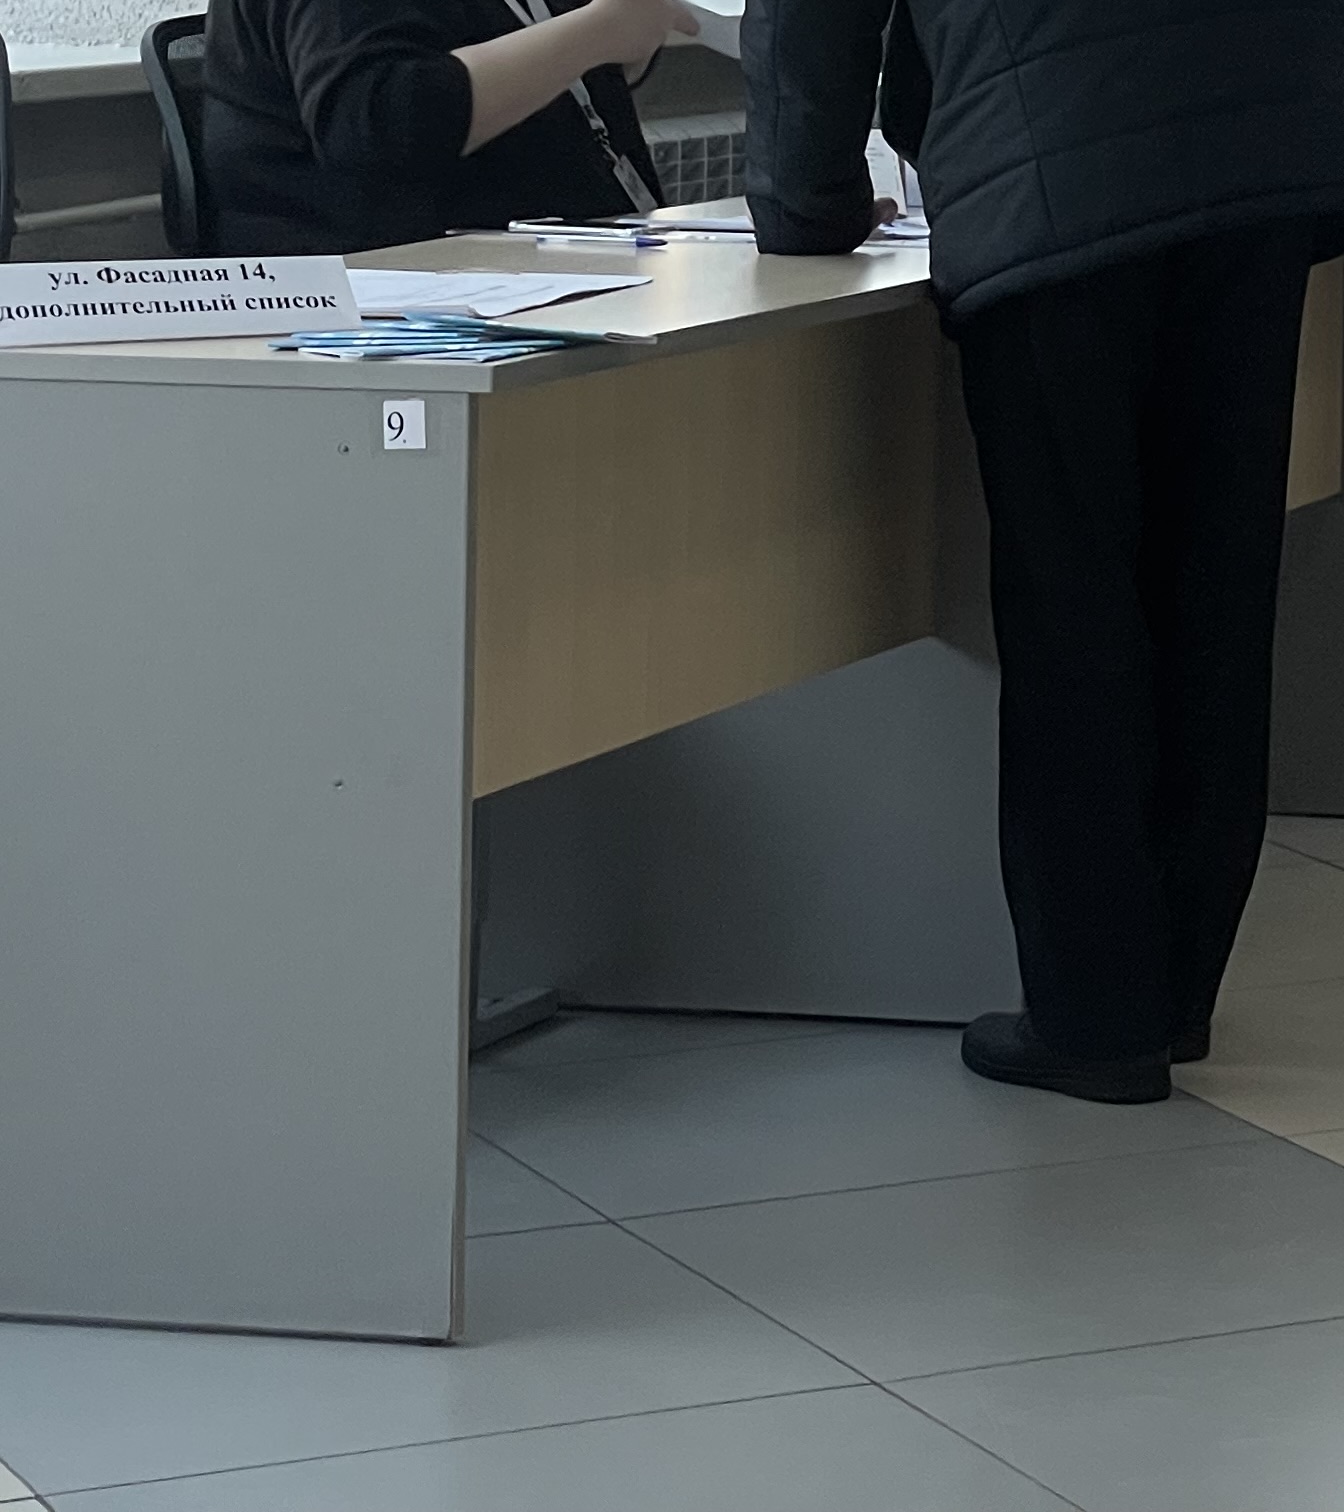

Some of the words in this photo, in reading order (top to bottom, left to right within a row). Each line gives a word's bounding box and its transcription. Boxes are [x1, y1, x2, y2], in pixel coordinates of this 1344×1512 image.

[48, 272, 89, 291] ул.
[96, 266, 229, 285] Фасадная
[239, 262, 276, 283] 14,
[0, 294, 238, 322] дополнительный
[245, 293, 337, 312] список
